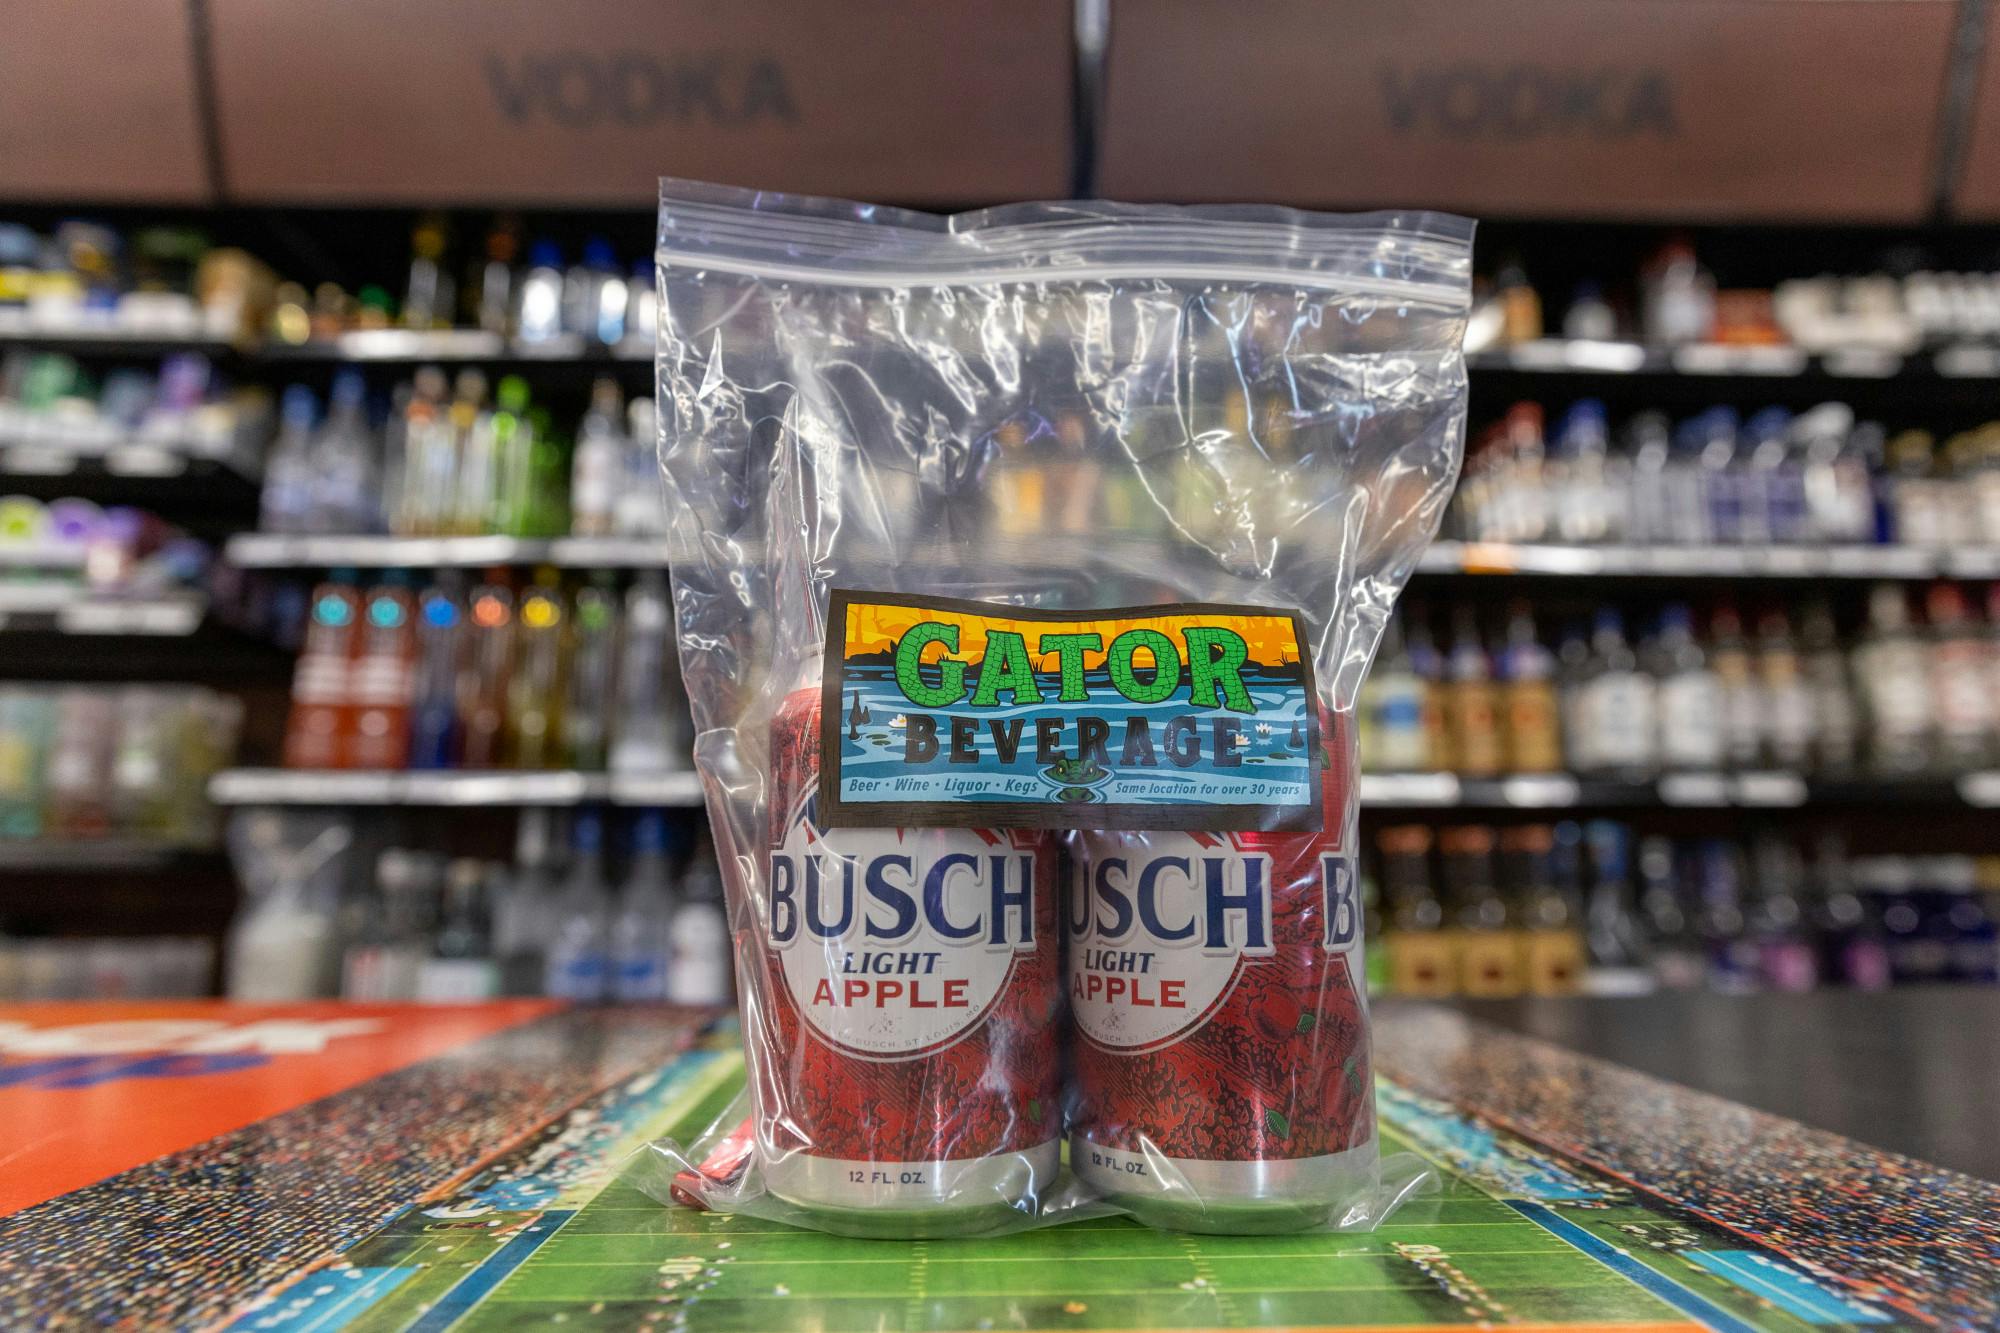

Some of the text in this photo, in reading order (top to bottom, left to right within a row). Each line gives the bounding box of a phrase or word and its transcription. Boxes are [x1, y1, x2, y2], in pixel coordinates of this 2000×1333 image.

[483, 52, 799, 127] VODKA
[1378, 65, 1674, 138] VODKA
[894, 622, 1259, 714] GATOR
[904, 715, 1243, 768] BEVERAGE
[849, 778, 1038, 795] Beer Wine Liquor Kegs
[1115, 782, 1300, 797] Same location for over 30 years
[770, 852, 1034, 946] BUSCH
[842, 951, 942, 975] LIGHT
[1085, 948, 1156, 974] LIGHT
[812, 978, 970, 1009] APPLE
[1072, 972, 1186, 1009] APPLE
[1092, 1152, 1102, 1166] 12
[849, 1171, 926, 1184] 12 FL. OZ.
